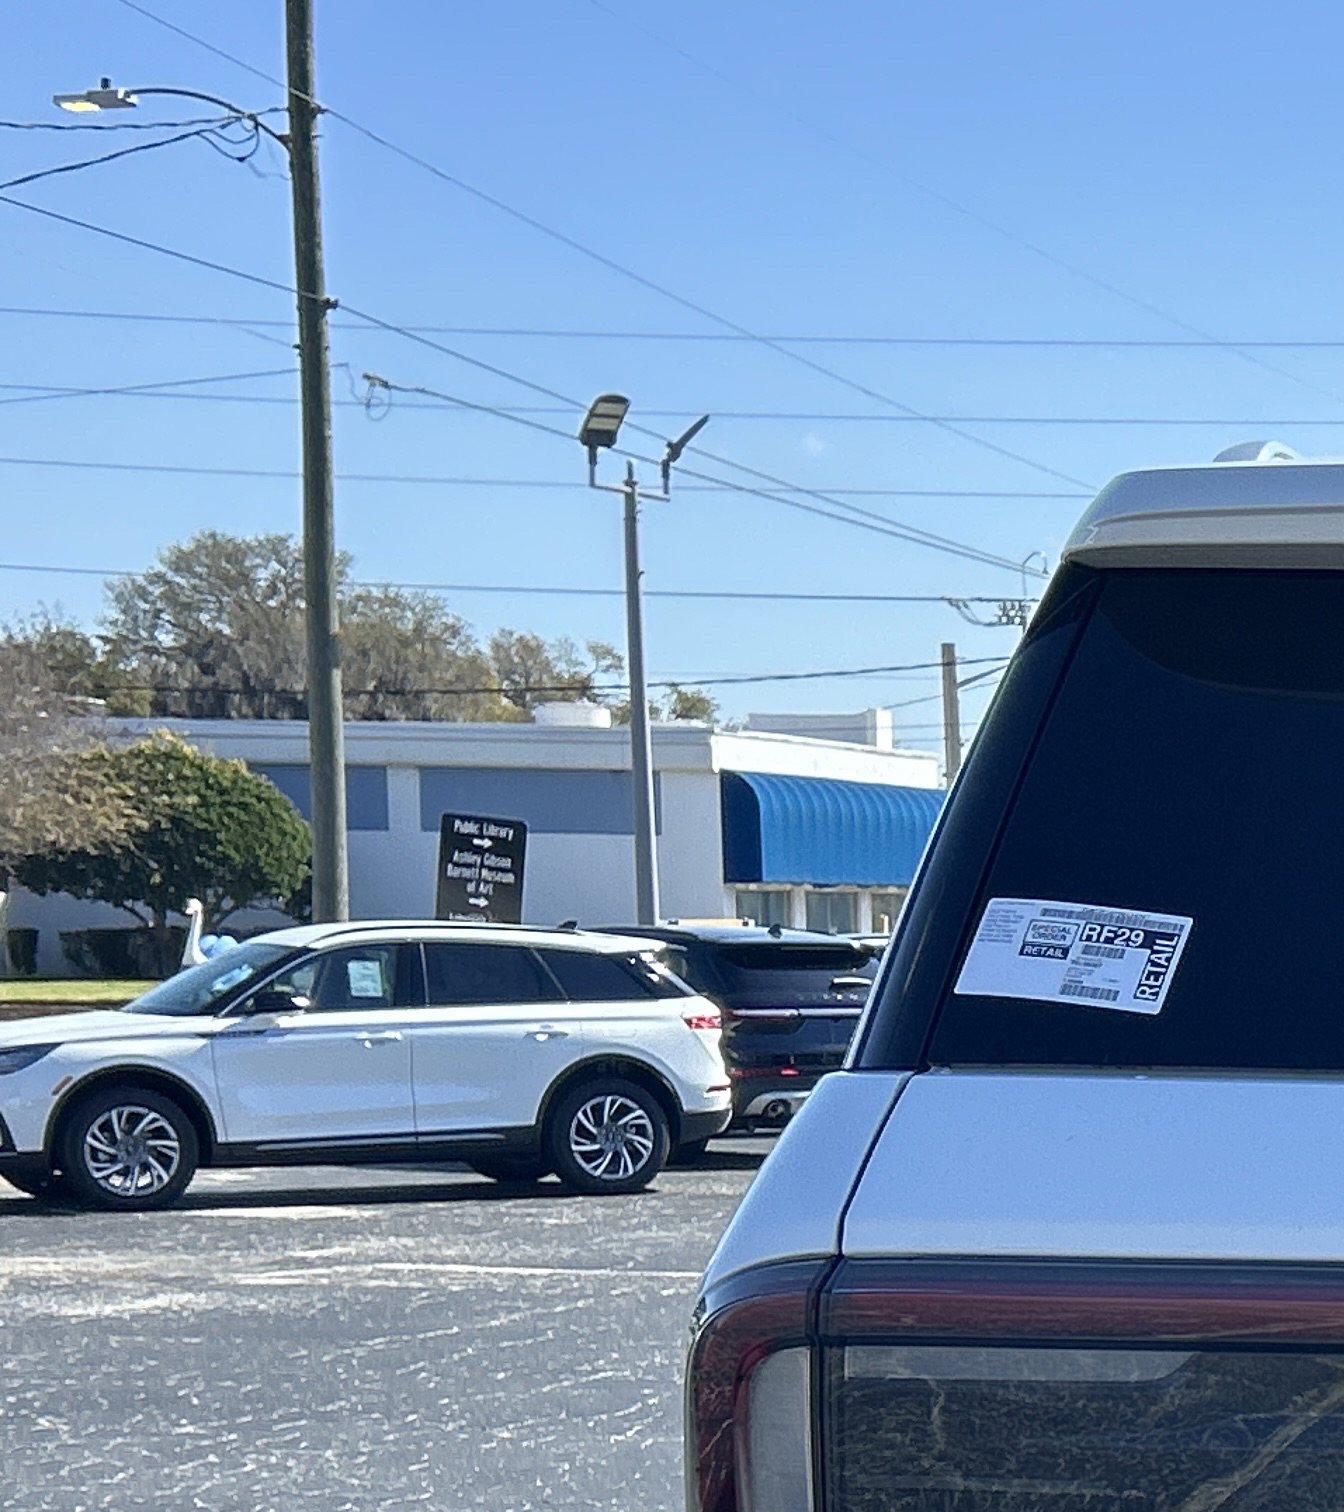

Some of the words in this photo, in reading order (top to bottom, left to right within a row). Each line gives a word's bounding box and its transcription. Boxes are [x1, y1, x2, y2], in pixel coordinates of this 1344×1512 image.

[453, 819, 480, 835] Public
[482, 823, 514, 841] Library
[452, 848, 481, 866] Ashley
[483, 852, 513, 868] Gibson
[446, 863, 480, 879] Barnett
[481, 868, 515, 884] Museum
[466, 880, 477, 893] of
[478, 881, 494, 896] Art
[1031, 924, 1072, 935] SPECIAL
[1031, 932, 1068, 942] ORDER
[1081, 923, 1145, 947] RF29
[1022, 945, 1065, 957] RETAIL
[1136, 934, 1179, 1000] RETAIL
